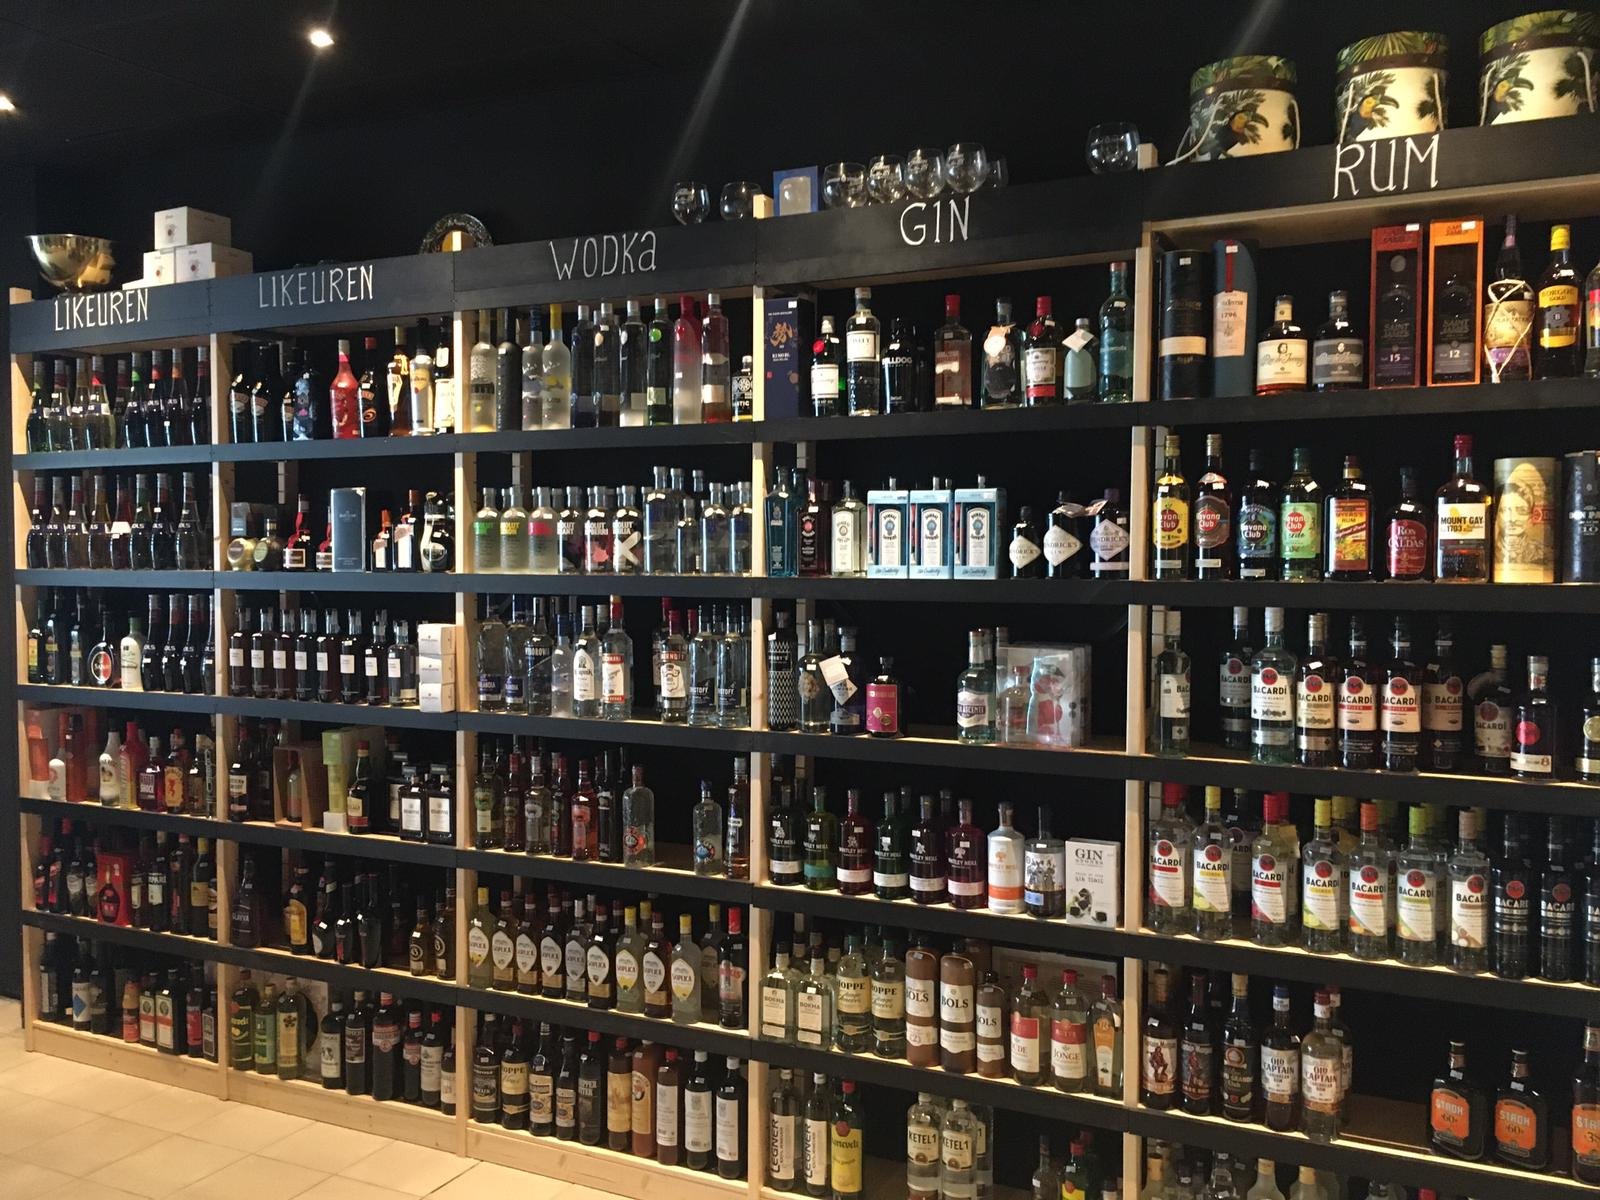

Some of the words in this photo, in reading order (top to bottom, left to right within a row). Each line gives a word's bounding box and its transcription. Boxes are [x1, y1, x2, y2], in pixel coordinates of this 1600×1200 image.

[1333, 134, 1440, 199] RUM
[899, 196, 971, 246] GIN
[259, 264, 375, 309] LIKEUREN
[54, 288, 149, 332] LIKEUREN
[1448, 350, 1460, 358] 12
[1440, 516, 1467, 525] MOUNT
[1469, 515, 1484, 524] GAY
[1075, 848, 1103, 861] GIN
[942, 996, 969, 1009] BOLS
[1435, 1098, 1463, 1115] STROH
[1499, 1110, 1530, 1125] STROH
